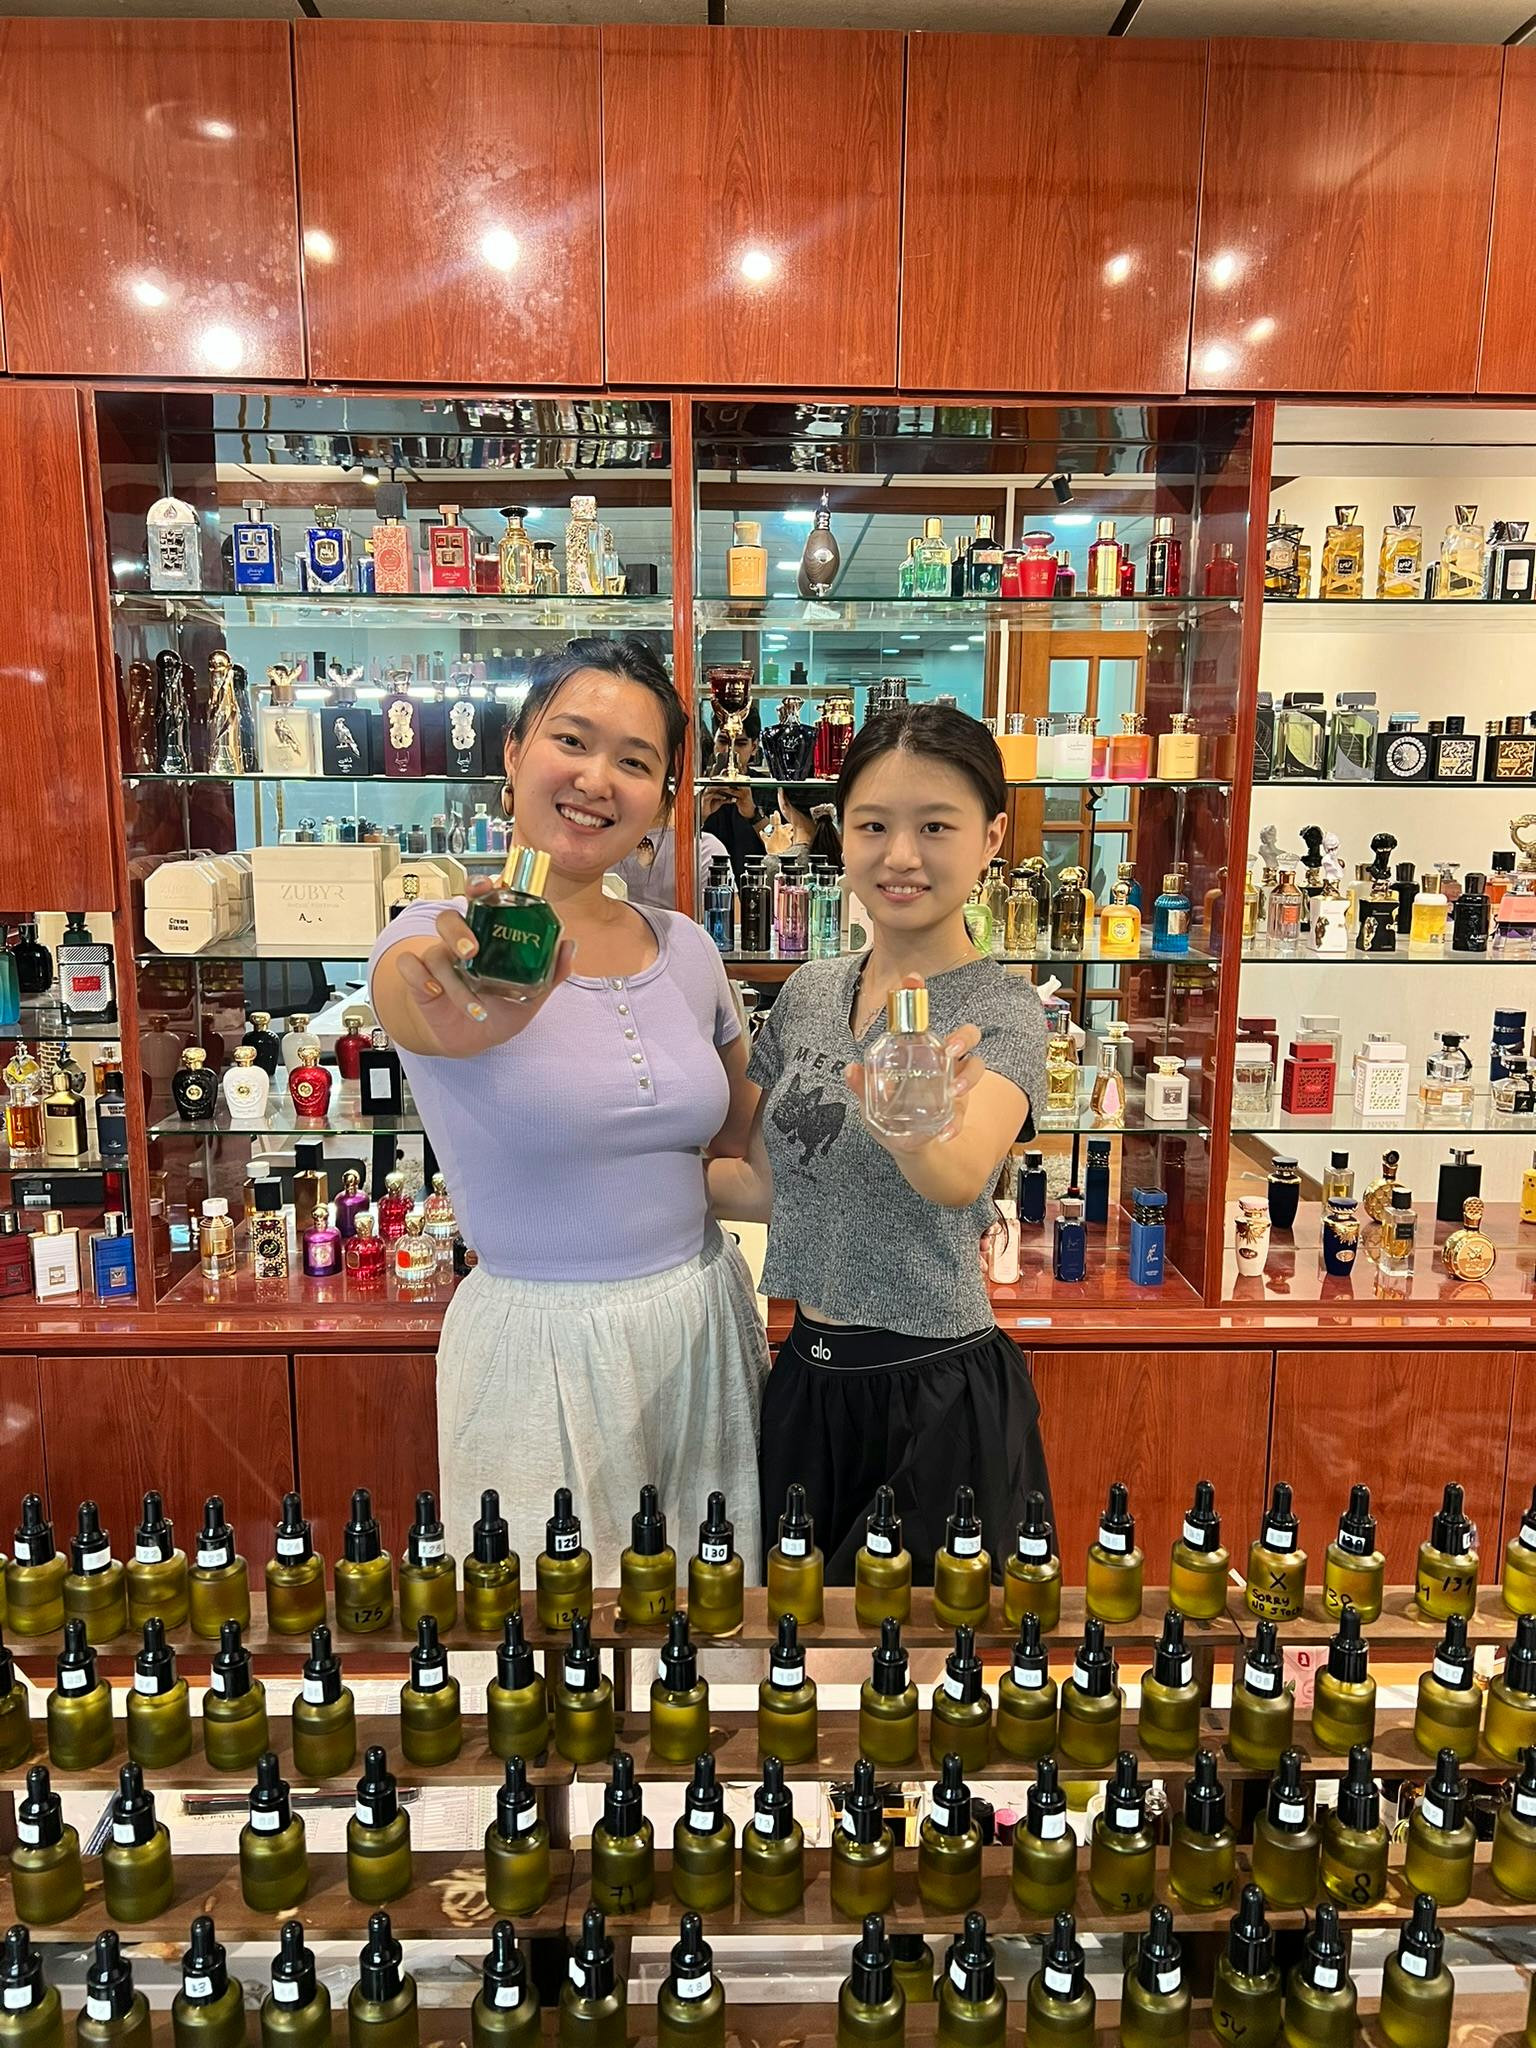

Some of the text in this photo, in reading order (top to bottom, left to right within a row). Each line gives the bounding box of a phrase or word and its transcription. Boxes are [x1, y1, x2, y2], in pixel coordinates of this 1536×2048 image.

[281, 884, 346, 901] ZUBYR
[492, 924, 541, 949] ZUBYR
[811, 1337, 832, 1361] alo
[557, 1535, 579, 1551] 128
[704, 1546, 726, 1559] 130
[1251, 1600, 1265, 1612] NO
[1252, 1588, 1290, 1607] SORRY
